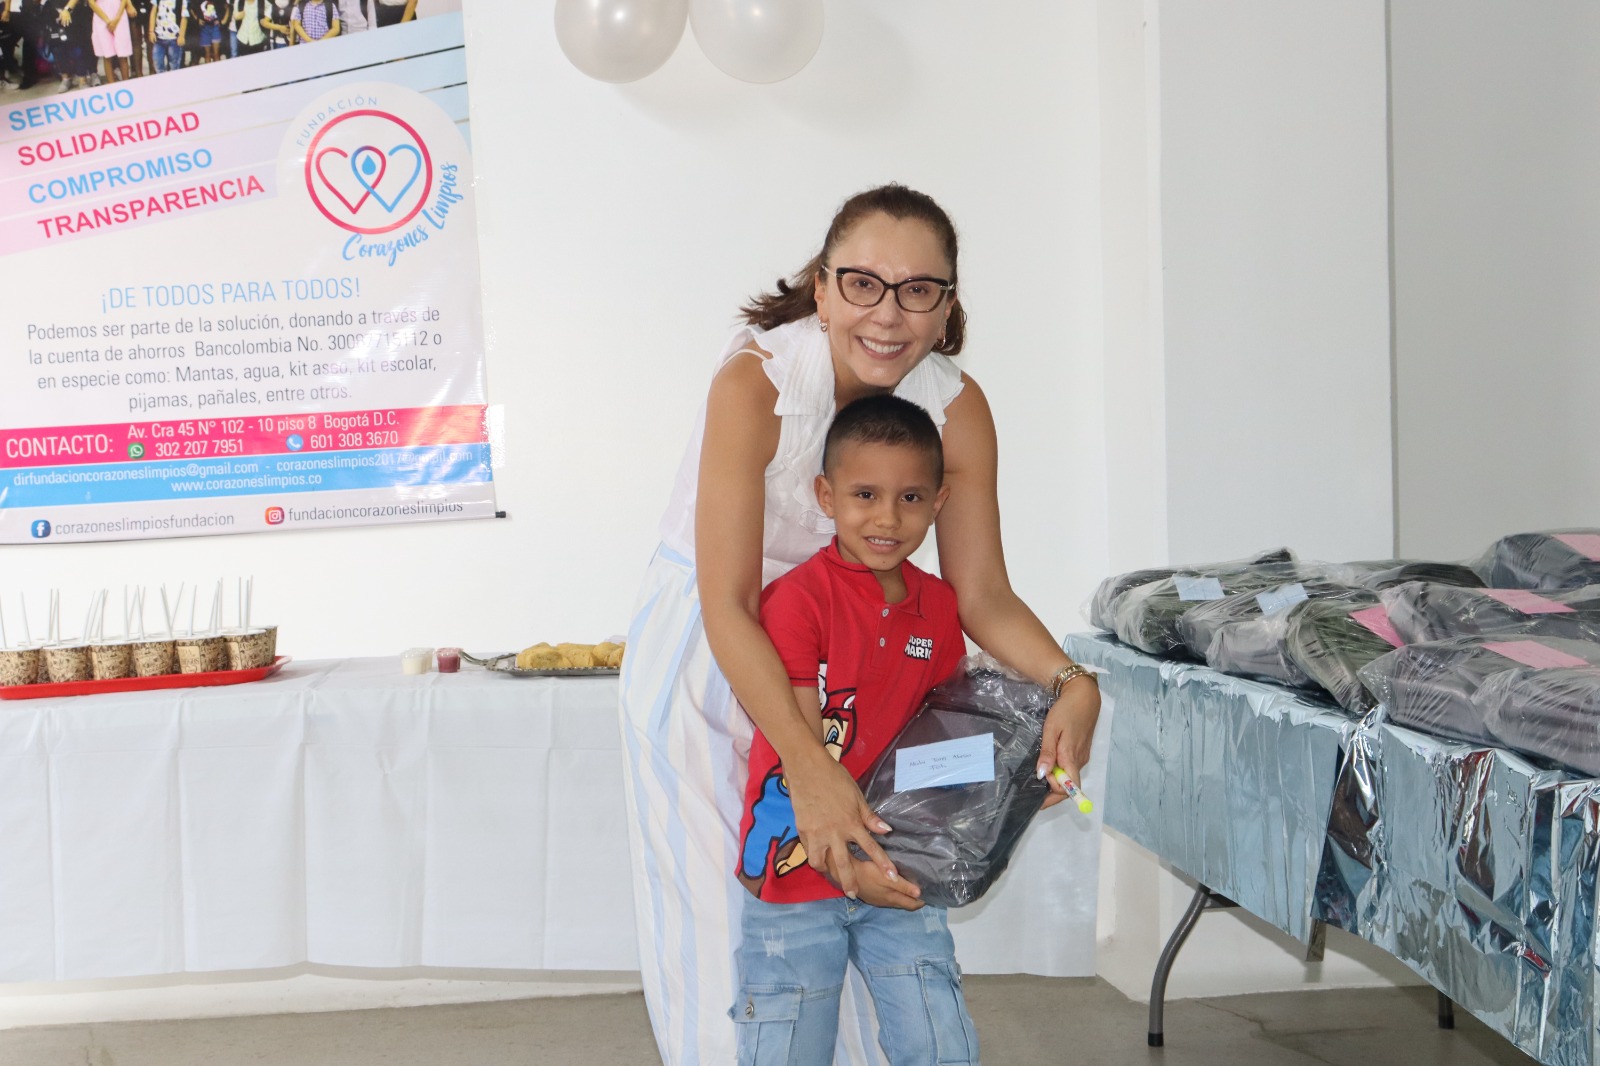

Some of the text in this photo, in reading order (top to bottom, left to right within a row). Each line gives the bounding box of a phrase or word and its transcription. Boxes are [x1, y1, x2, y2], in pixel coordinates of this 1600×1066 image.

[9, 89, 134, 131] SERVICIO
[296, 94, 378, 147] FUNDACIÓN
[18, 112, 200, 166] SOLIDARIDAD
[29, 149, 212, 204] COMPROMISO
[37, 174, 265, 238] TRANSPARENCIA
[342, 161, 464, 267] Corazones Limpios
[102, 277, 360, 313] ¡DE TODOS PARA TODOS!
[28, 307, 440, 340] Podemos ser parte de la solución, donando a través de
[29, 349, 42, 364] la
[48, 350, 99, 364] cuenta
[105, 346, 123, 361] de
[128, 344, 185, 360] ahorros
[195, 337, 292, 357] Bancolombia
[297, 336, 322, 351] No.
[433, 333, 442, 346] o
[38, 376, 56, 389] en
[62, 370, 120, 390] especie
[125, 371, 170, 385] como:
[176, 366, 238, 383] Mantas,
[243, 365, 284, 383] agua,
[290, 361, 308, 377] kit
[357, 358, 375, 374] kit
[381, 355, 436, 373] escolar,
[129, 384, 352, 413] pijamas, pañales, entre otros.
[127, 425, 148, 439] Av.
[152, 423, 174, 438] Cra
[177, 422, 194, 436] 45
[221, 420, 244, 434] 102
[258, 418, 273, 432] 10
[277, 416, 304, 434] piso
[308, 417, 316, 430] 8
[324, 414, 369, 432] Bogotá
[373, 411, 400, 426] D.C.
[310, 431, 399, 449] 601 308 3670
[6, 433, 114, 459] CONTACTO:
[155, 439, 243, 457] 302 207 7951
[13, 462, 259, 486] dirfundacioncorazoneslimpios@gmail.com
[171, 473, 322, 493] www.corazoneslimpios.co
[55, 512, 234, 535] corazoneslimpiosfundacion
[288, 499, 463, 522] fundacioncorazoneslimpios
